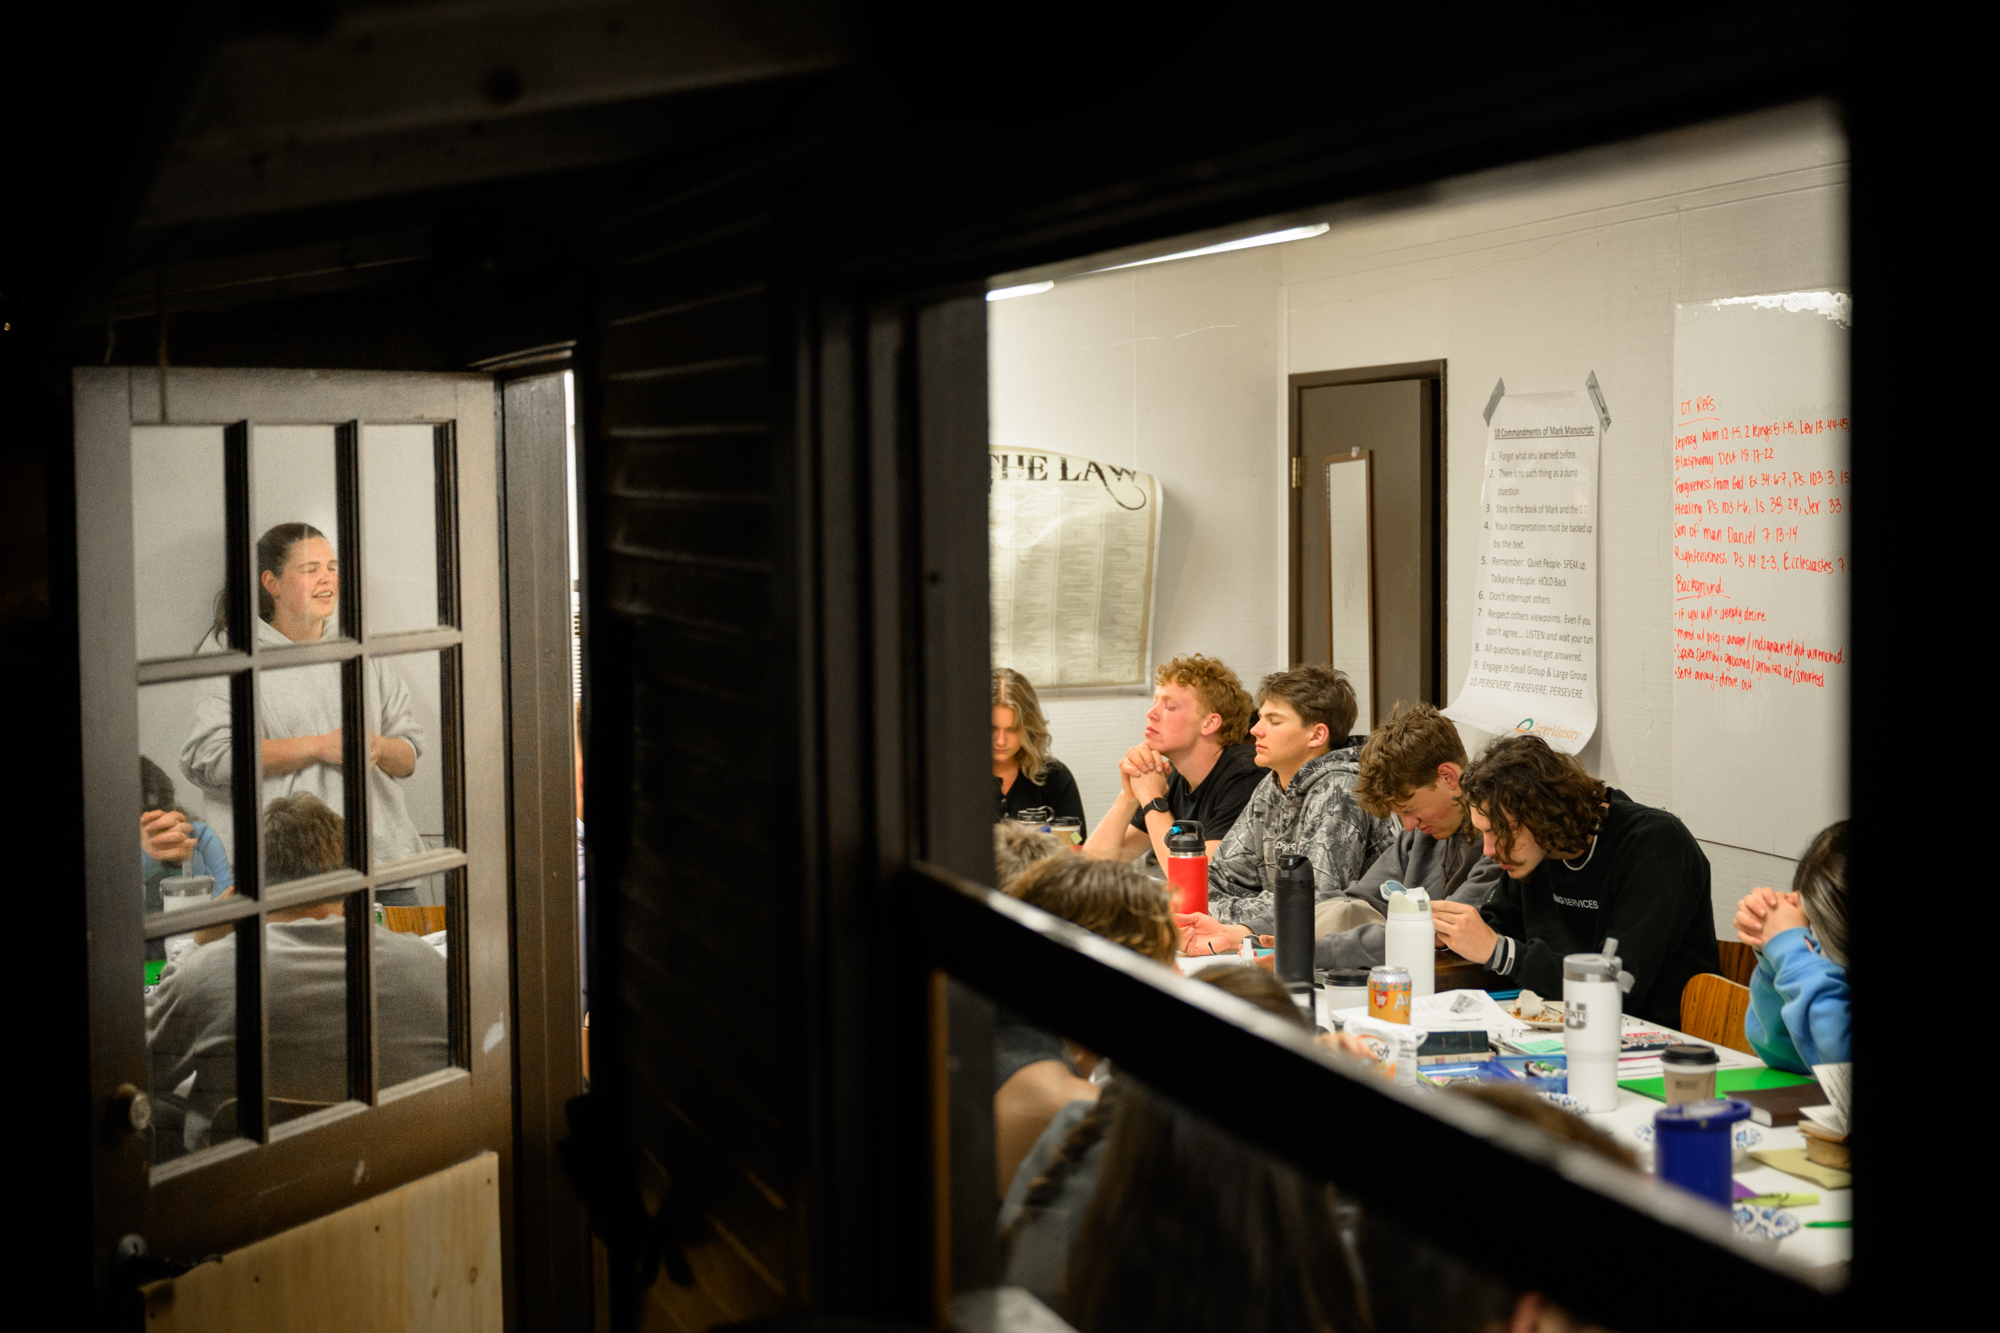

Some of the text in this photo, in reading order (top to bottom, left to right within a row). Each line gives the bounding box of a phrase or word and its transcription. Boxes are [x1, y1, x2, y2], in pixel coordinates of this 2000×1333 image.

[1681, 400, 1692, 415] OT
[1494, 428, 1500, 438] 10
[1501, 427, 1541, 437] Commandments
[1543, 426, 1549, 435] of
[1549, 426, 1564, 435] Mark
[1745, 425, 1750, 438] 2
[1799, 419, 1814, 435] Lev
[1499, 452, 1514, 462] Forget
[1515, 451, 1527, 460] what
[1528, 452, 1537, 461] you
[1538, 450, 1558, 460] learned
[1499, 469, 1512, 478] There
[1526, 469, 1537, 478] such
[1538, 469, 1552, 479] thing
[1564, 468, 1578, 477] dumb
[1497, 487, 1519, 497] question
[1496, 504, 1508, 514] Stay
[1509, 504, 1514, 513] in
[1515, 504, 1524, 513] the
[1525, 504, 1537, 514] book
[1538, 504, 1545, 514] of
[1545, 505, 1558, 514] Mark
[1559, 505, 1569, 514] and
[1570, 505, 1578, 514] the
[1495, 521, 1508, 531] Your
[1509, 522, 1547, 533] interpretations
[1547, 523, 1561, 532] must
[1561, 523, 1568, 532] be
[1569, 523, 1586, 533] backed
[1586, 525, 1592, 534] up
[1689, 522, 1699, 538] of
[1727, 525, 1756, 545] Daniel
[1493, 539, 1500, 549] by
[1502, 540, 1511, 548] the
[1527, 558, 1542, 567] Quiet
[1563, 559, 1579, 570] SPEAK
[1491, 573, 1515, 584] Talkative
[1538, 576, 1553, 586] HOLD
[1554, 577, 1567, 587] Back
[1506, 593, 1532, 604] interrupt
[1532, 594, 1550, 604] others
[1488, 608, 1510, 621] Respect
[1511, 611, 1529, 621] others
[1564, 614, 1577, 624] Even
[1582, 617, 1591, 627] you
[1525, 629, 1545, 640] LISTEN
[1546, 632, 1558, 641] and
[1558, 633, 1570, 643] wait
[1570, 634, 1582, 645] your
[1583, 635, 1594, 644] turn
[1484, 643, 1492, 653] All
[1493, 645, 1520, 656] questions
[1521, 647, 1532, 656] will
[1532, 648, 1542, 658] not
[1543, 650, 1553, 660] get
[1482, 661, 1502, 673] Engage
[1503, 663, 1510, 672] in
[1510, 664, 1526, 674] Small
[1527, 666, 1545, 677] Group
[1546, 667, 1551, 677] &
[1552, 668, 1568, 680] Large
[1569, 670, 1587, 682] Group
[1513, 682, 1548, 696] PERSEVERE,
[1550, 686, 1583, 698] PERSEVERE
[1531, 723, 1582, 742] InterVarsity
[1563, 897, 1599, 909] SERVICES
